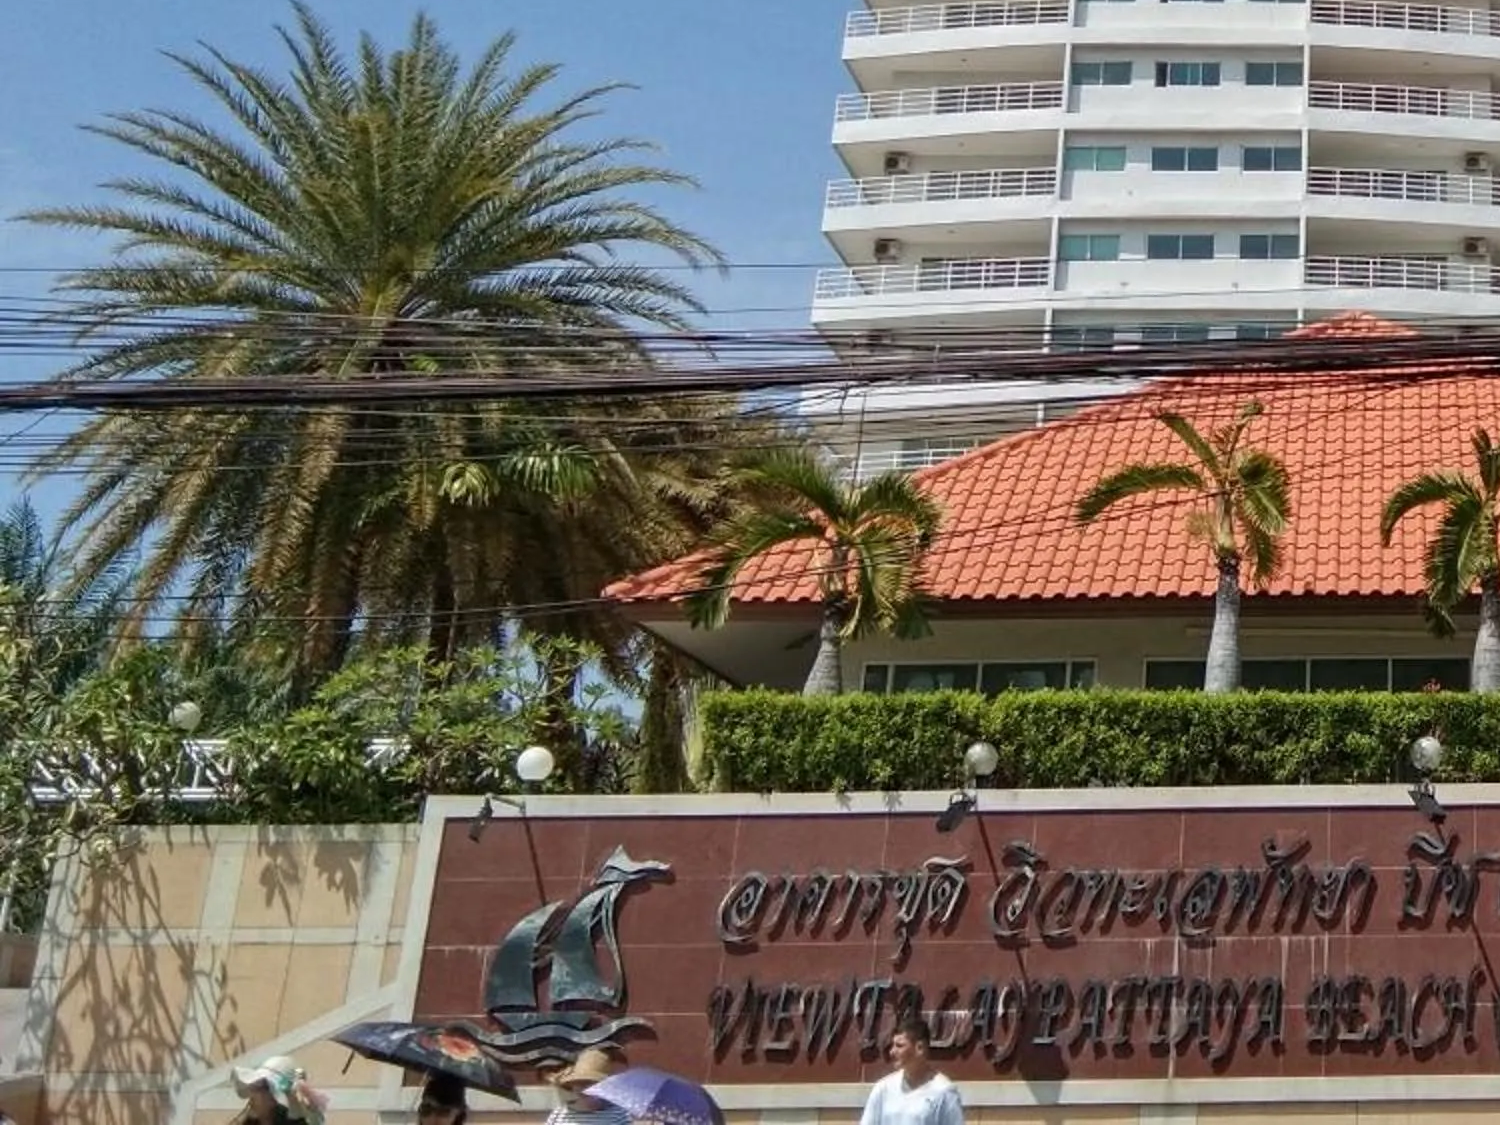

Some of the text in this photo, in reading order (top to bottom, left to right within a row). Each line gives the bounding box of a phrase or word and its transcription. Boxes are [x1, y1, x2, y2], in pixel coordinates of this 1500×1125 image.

[717, 854, 970, 963] อาคารชุด
[988, 835, 1375, 936] วิวทะเลพัทยา
[1032, 975, 1284, 1061] PATTAYA
[1305, 965, 1483, 1049] BEACH
